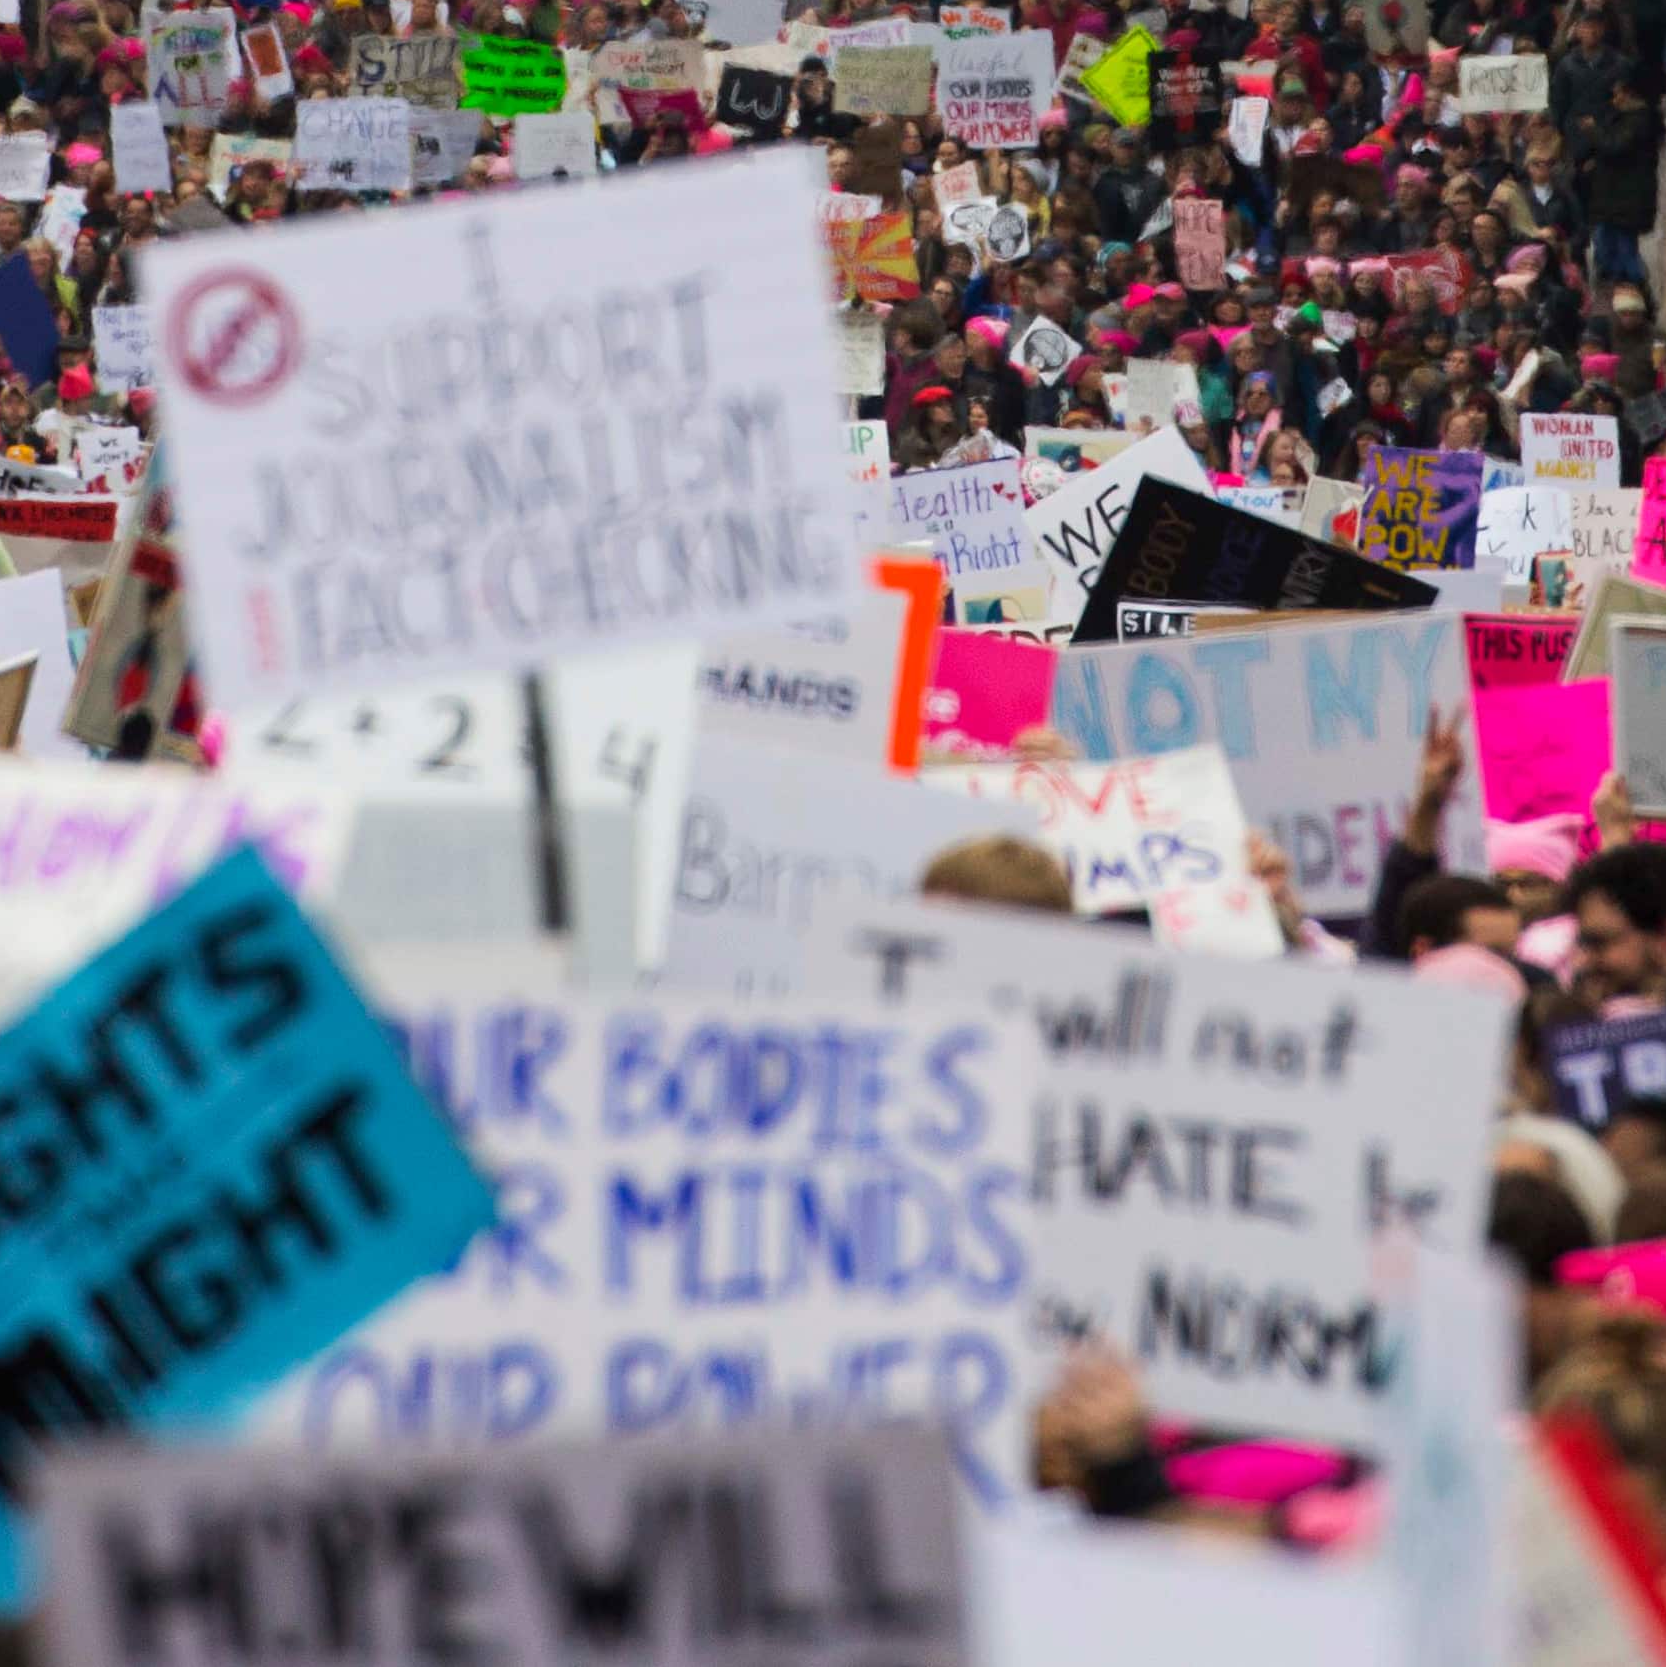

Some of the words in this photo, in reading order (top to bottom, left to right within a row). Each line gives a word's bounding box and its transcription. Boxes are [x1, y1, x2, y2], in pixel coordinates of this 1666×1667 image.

[946, 101, 982, 120] OUR
[985, 100, 1032, 120] MINDS
[949, 81, 982, 99] OUR
[983, 120, 1034, 144] POWER
[311, 269, 715, 439] SUPPORT
[1373, 451, 1439, 488] WE
[1560, 439, 1615, 460] UNITED
[1367, 487, 1444, 523] ARE
[951, 526, 1023, 576] Right
[1361, 524, 1451, 563] POW
[1469, 629, 1525, 662] THIS
[1051, 637, 1271, 761] NOT
[1306, 617, 1450, 747] MY
[1038, 964, 1179, 1062] will
[1193, 1002, 1362, 1084] not
[601, 1009, 995, 1157] BODIES
[1026, 1097, 1320, 1227] HATE
[601, 1160, 1033, 1311] MINDS
[511, 1464, 945, 1654] WILL
